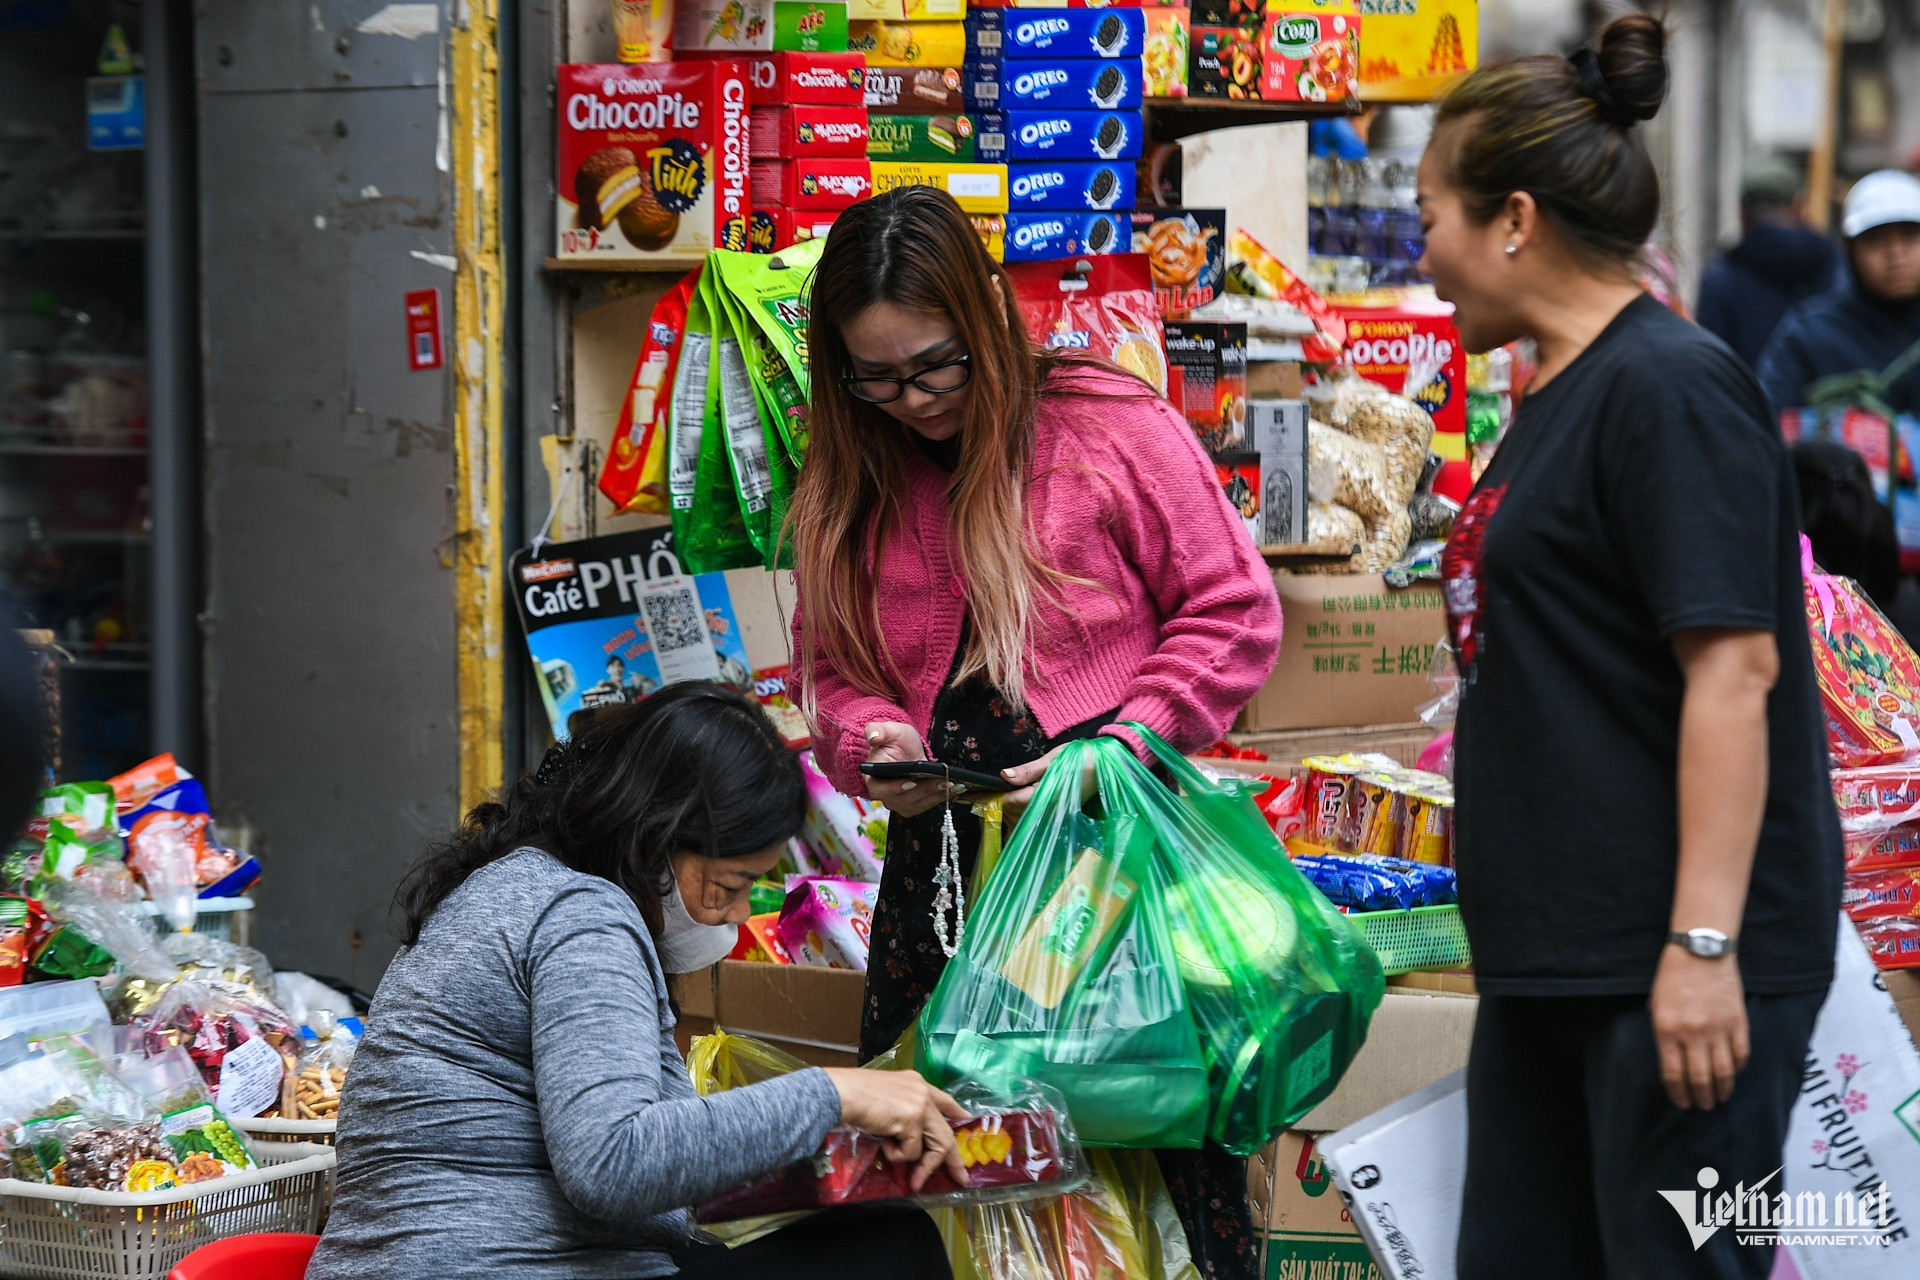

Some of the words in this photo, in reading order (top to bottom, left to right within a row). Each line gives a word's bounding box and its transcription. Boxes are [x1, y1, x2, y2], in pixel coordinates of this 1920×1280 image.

[1016, 18, 1070, 44] OREO
[1278, 23, 1317, 43] Cozy
[797, 72, 848, 88] ChocoPie
[865, 75, 903, 95] COLAT
[1014, 69, 1069, 95] OREO
[567, 92, 700, 131] ChocoPie
[868, 124, 914, 142] OCOLAT
[1020, 119, 1071, 144] OREO
[723, 78, 747, 214] ChocoPie
[1012, 171, 1065, 198] OREO
[1014, 219, 1065, 247] OREO
[1166, 337, 1216, 353] wake-up
[525, 577, 584, 618] Café
[754, 676, 786, 697] OSY
[1899, 836, 1920, 852] NH
[1800, 1056, 1831, 1093] MI
[1811, 1091, 1875, 1169] FRUIT
[1853, 1172, 1910, 1249] WINE
[1279, 1251, 1306, 1280] SẢN
[1309, 1252, 1340, 1280] XUẤT
